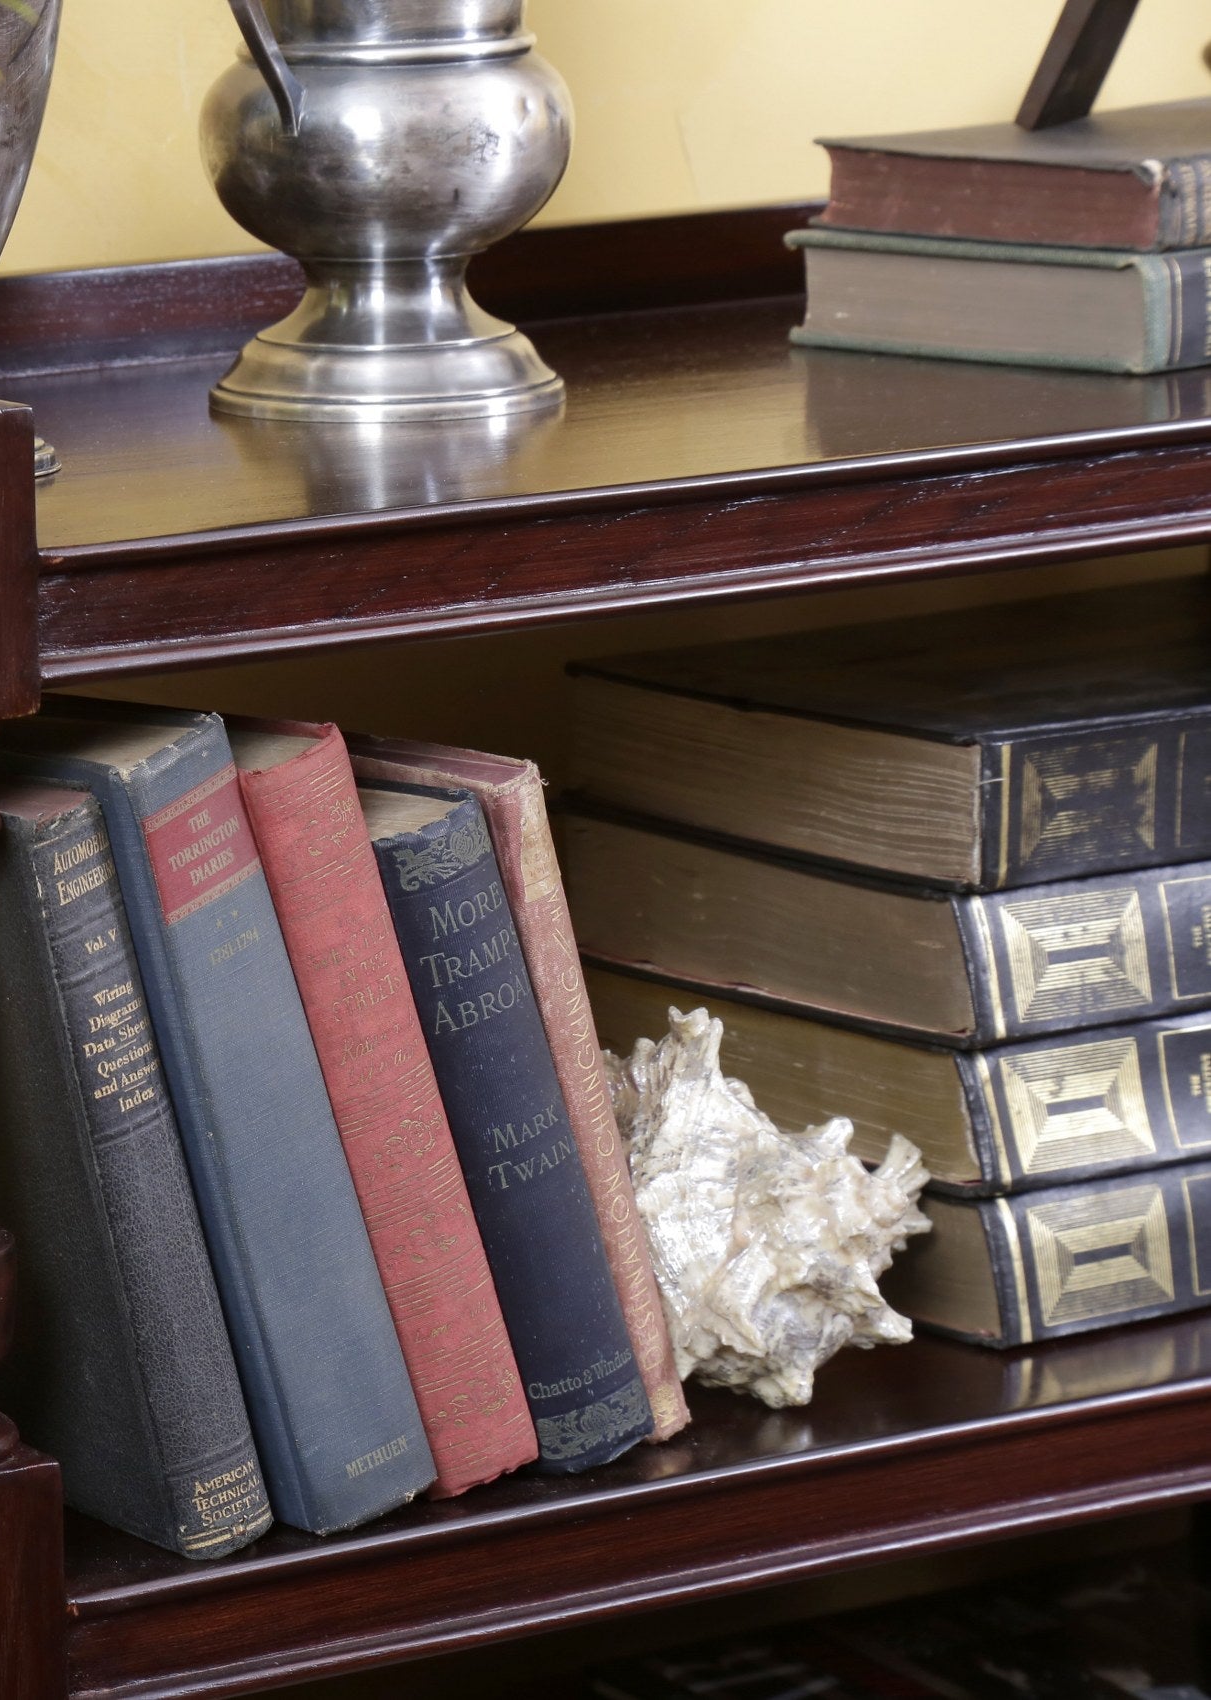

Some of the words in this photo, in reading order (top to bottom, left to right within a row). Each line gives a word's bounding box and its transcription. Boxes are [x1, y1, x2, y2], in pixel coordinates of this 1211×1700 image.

[188, 808, 212, 834] THE
[53, 831, 110, 876] AUTOMOBIL
[168, 815, 241, 873] TORRINGTON
[190, 847, 236, 887] DIARIES
[428, 881, 503, 942] MORE
[84, 935, 107, 955] Vol.
[107, 927, 117, 942] V
[419, 920, 520, 988] TRAMPS
[93, 980, 134, 1007] Wiring
[82, 1037, 116, 1058] Data
[97, 1040, 154, 1078] Questions
[560, 965, 616, 1158] CHUNGKING
[94, 1078, 119, 1099] and
[118, 1086, 155, 1113] Index
[492, 1104, 559, 1153] MARK
[488, 1135, 573, 1189] TWAIN
[603, 1168, 666, 1371] DESTINATION
[528, 1376, 582, 1400] Chatto
[583, 1369, 593, 1385] &
[591, 1348, 632, 1379] Windus
[345, 1434, 408, 1479] METHUEN
[192, 1475, 260, 1512] TECHNICAL
[194, 1459, 255, 1497] AMERICAN
[200, 1489, 261, 1528] SOCIETY
